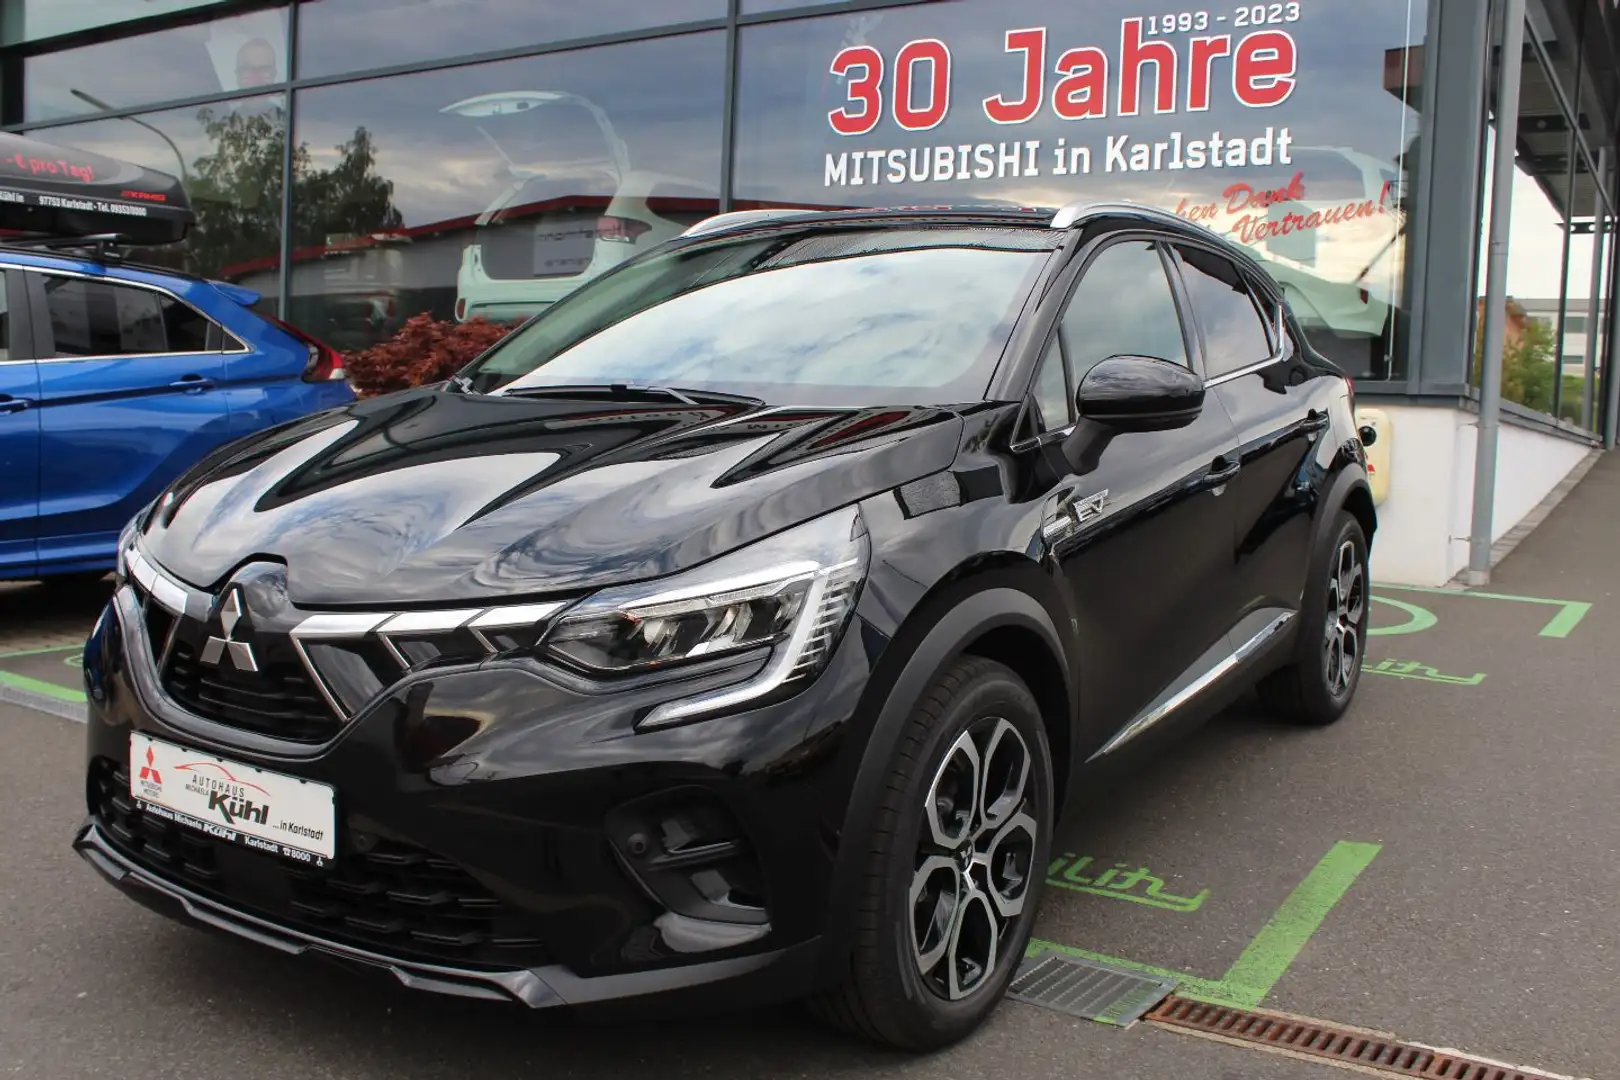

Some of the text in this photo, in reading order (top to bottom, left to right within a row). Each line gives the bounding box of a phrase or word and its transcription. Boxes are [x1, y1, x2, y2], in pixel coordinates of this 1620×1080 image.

[1147, 11, 1209, 35] 1993
[1234, 2, 1301, 27] 2023
[827, 16, 1297, 136] 30 Jahre
[28, 158, 58, 176] pro
[57, 159, 95, 183] Tag!
[824, 126, 1292, 187] MITSUBISHI in Karlstadt
[61, 198, 94, 211] Karlstadt
[1222, 170, 1306, 215] Dank
[1231, 179, 1391, 244] Vertrauen!
[191, 774, 245, 798] AUTOHAUS
[208, 790, 270, 825] Kühl
[146, 803, 174, 820] Autohaus
[174, 812, 203, 831] Michaela
[203, 822, 237, 842] Kühl
[244, 835, 279, 854] Karlstadt
[288, 821, 324, 841] Karlstadt
